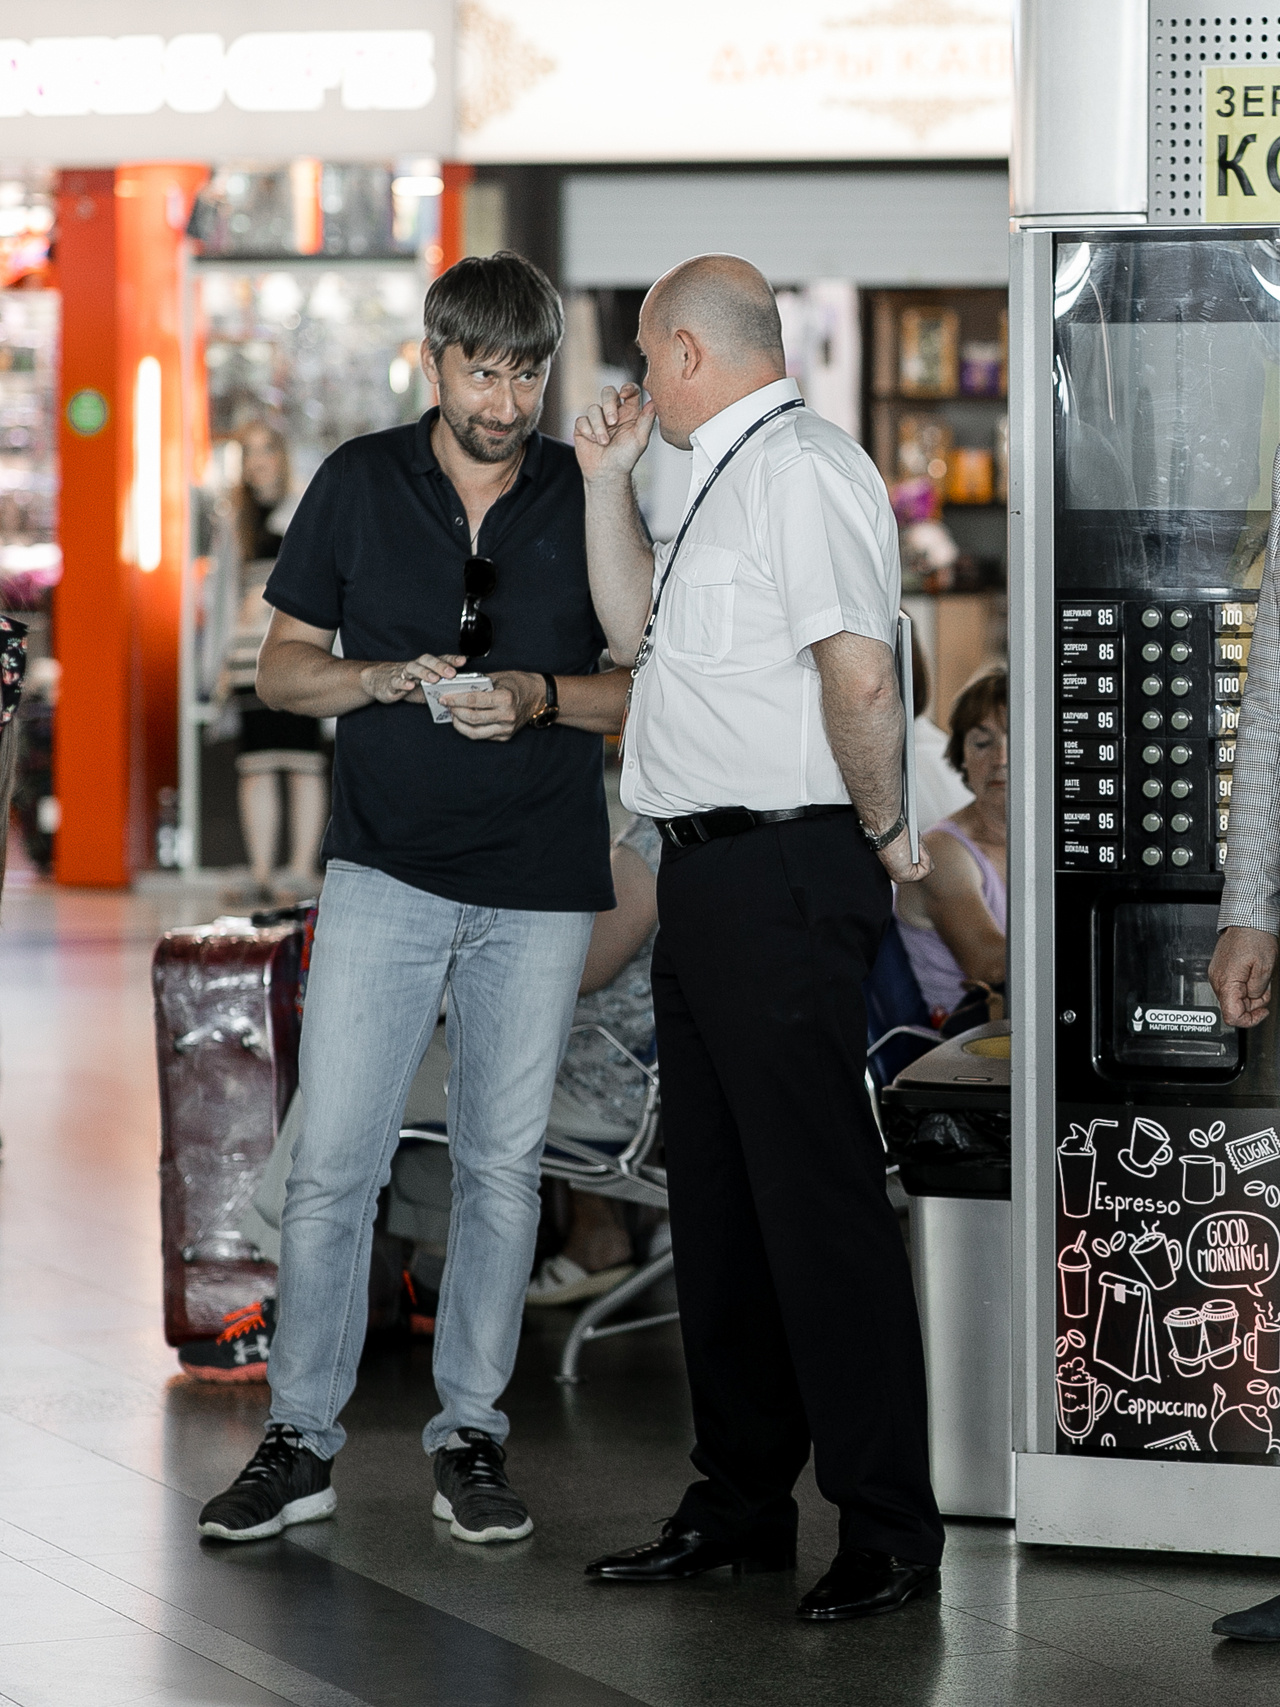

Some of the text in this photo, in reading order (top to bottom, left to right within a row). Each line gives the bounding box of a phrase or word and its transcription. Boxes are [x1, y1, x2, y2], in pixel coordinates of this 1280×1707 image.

[1098, 609, 1113, 625] 85
[1221, 609, 1243, 626] 100
[1063, 643, 1088, 651] ЭСПРЕССО
[1099, 643, 1114, 660] 85
[1221, 644, 1243, 660] 100
[1098, 677, 1113, 693] 95
[1217, 677, 1239, 693] 100
[1098, 712, 1113, 728] 95
[1099, 745, 1114, 761] 90
[1219, 747, 1235, 763] 90
[1099, 779, 1114, 795] 95
[1099, 813, 1114, 829] 95
[1099, 847, 1114, 863] 85
[1149, 1012, 1213, 1024] ОСТОРОЖНО
[1149, 1023, 1212, 1033] НАПИТОК ГОРЯЧИЙ!
[1237, 1137, 1274, 1164] SUGAR
[1095, 1181, 1181, 1222] Espresso
[1207, 1218, 1249, 1247] GOOD
[1197, 1243, 1270, 1273] MORNING!
[1114, 1389, 1207, 1425] Cappuccino
